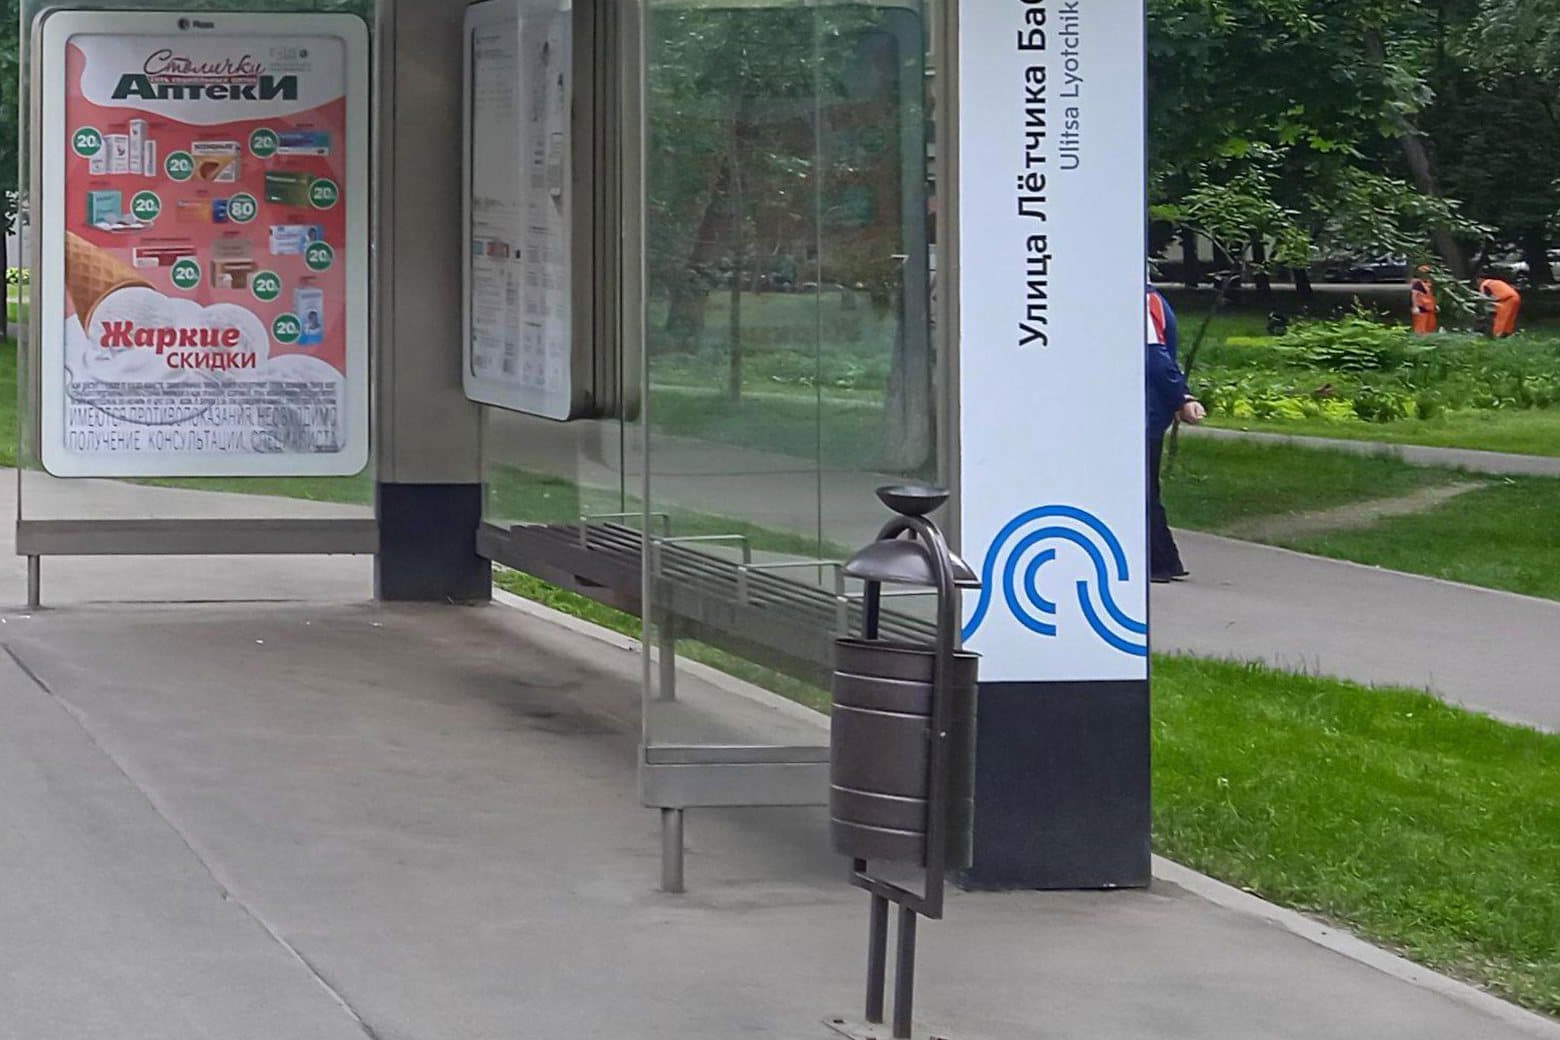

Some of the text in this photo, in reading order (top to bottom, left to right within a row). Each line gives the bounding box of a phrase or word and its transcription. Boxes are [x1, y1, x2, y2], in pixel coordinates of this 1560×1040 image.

[143, 48, 266, 75] Столички
[1017, 65, 1047, 222] Лётчика
[1058, 106, 1080, 170] Ulitsa
[1018, 235, 1052, 347] Улица
[100, 321, 240, 355] Жаркие
[69, 431, 140, 451] ПОЛУЧЕНИЕ
